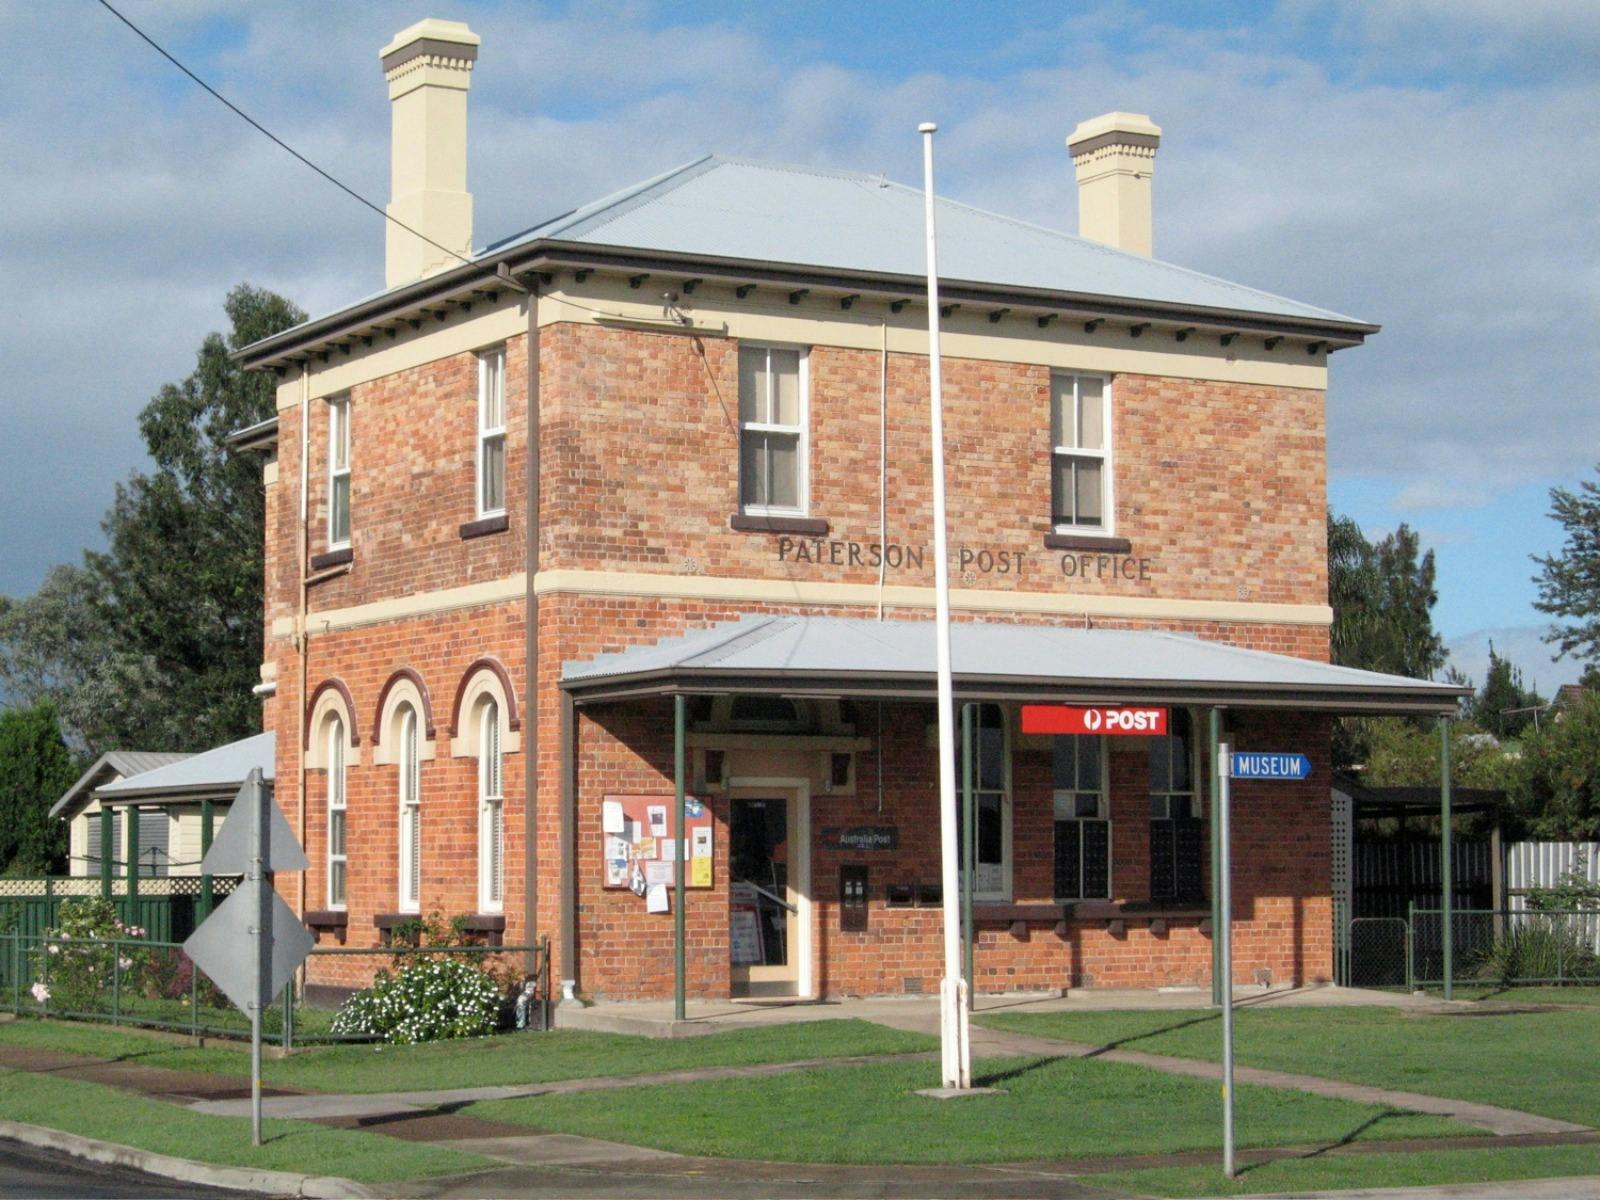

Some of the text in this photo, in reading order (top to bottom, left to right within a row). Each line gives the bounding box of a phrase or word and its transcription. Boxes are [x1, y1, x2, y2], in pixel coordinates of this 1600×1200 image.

[778, 536, 1152, 581] PATERSON POST OFFICE
[1105, 711, 1160, 730] POST
[1238, 756, 1301, 775] MUSEUM
